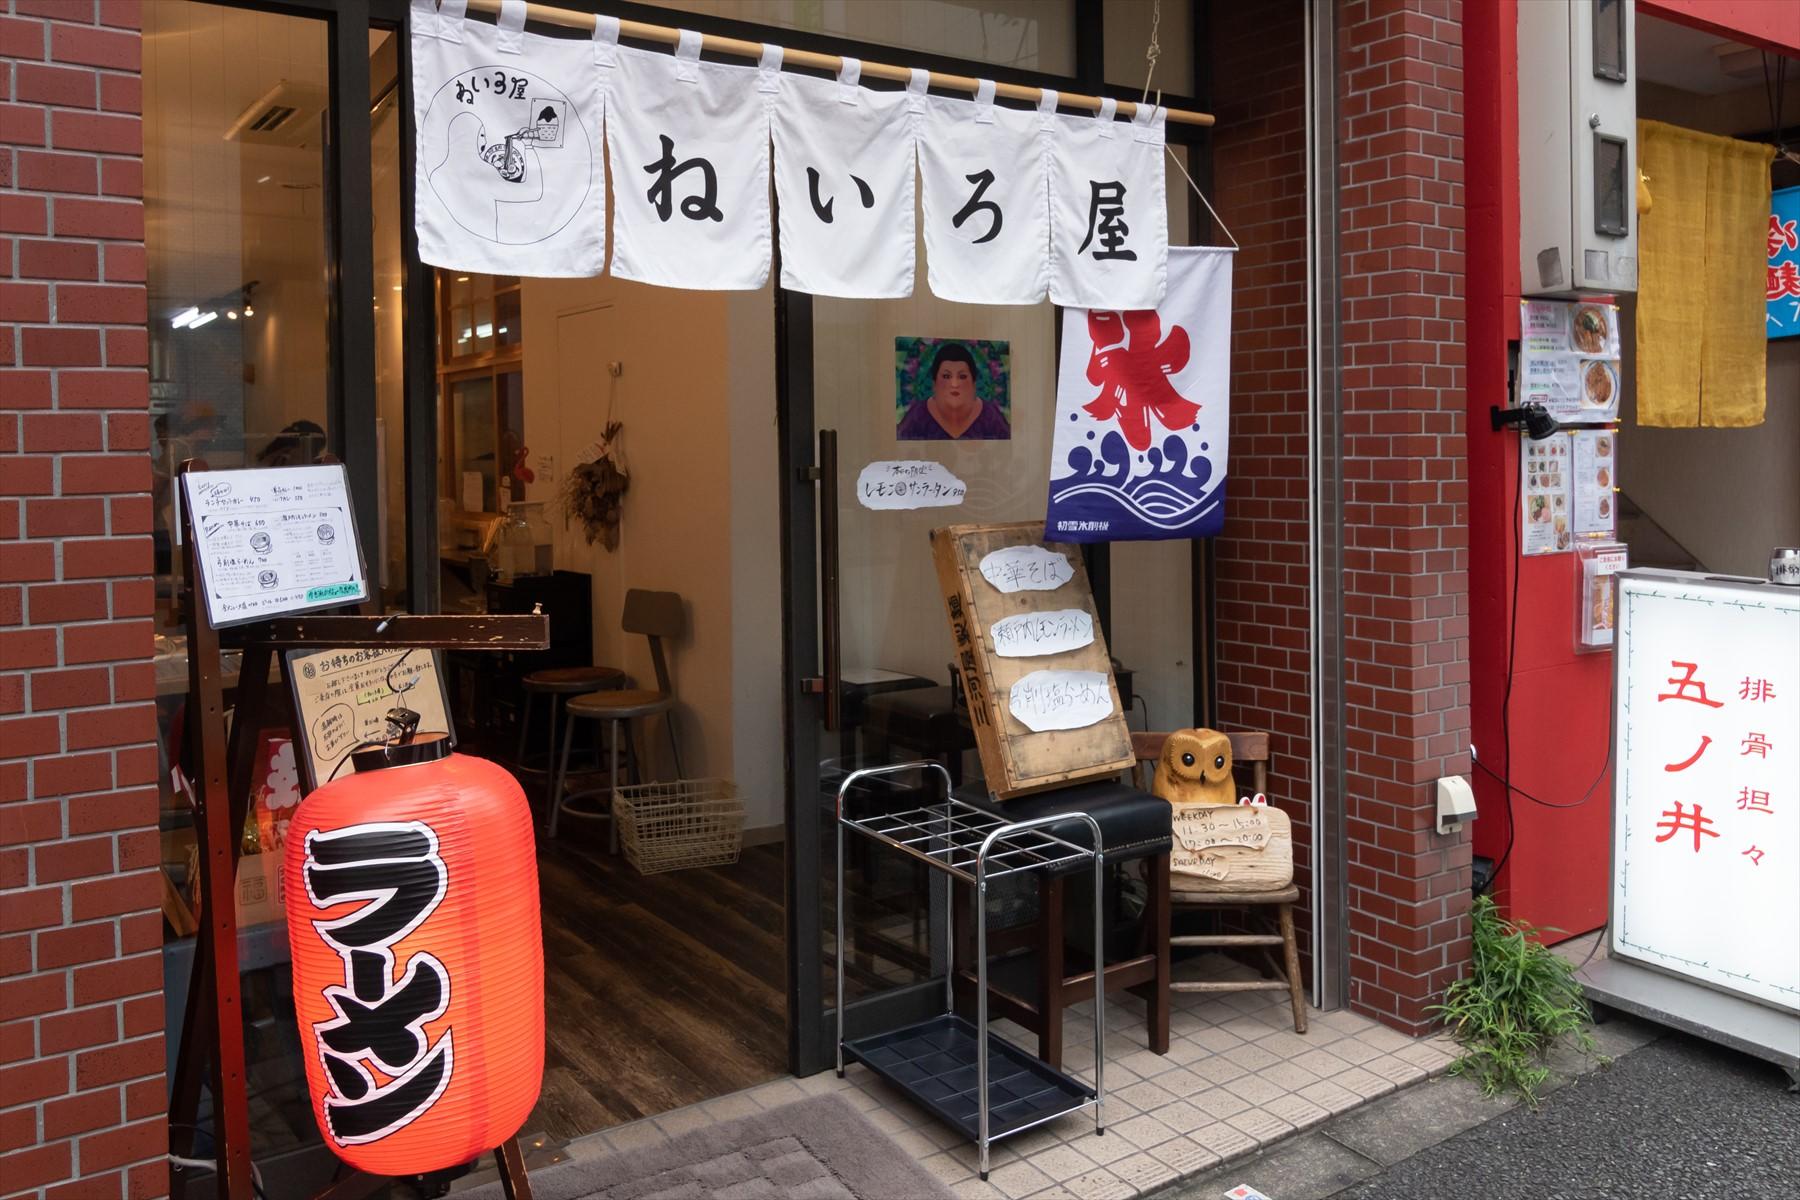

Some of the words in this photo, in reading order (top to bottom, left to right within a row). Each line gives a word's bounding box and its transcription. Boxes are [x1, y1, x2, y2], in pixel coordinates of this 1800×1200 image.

[643, 134, 1138, 262] ねいろ屋
[1655, 660, 1725, 853] 五ノ井
[1736, 676, 1777, 867] 排骨担々
[303, 819, 455, 1147] ラーメン
